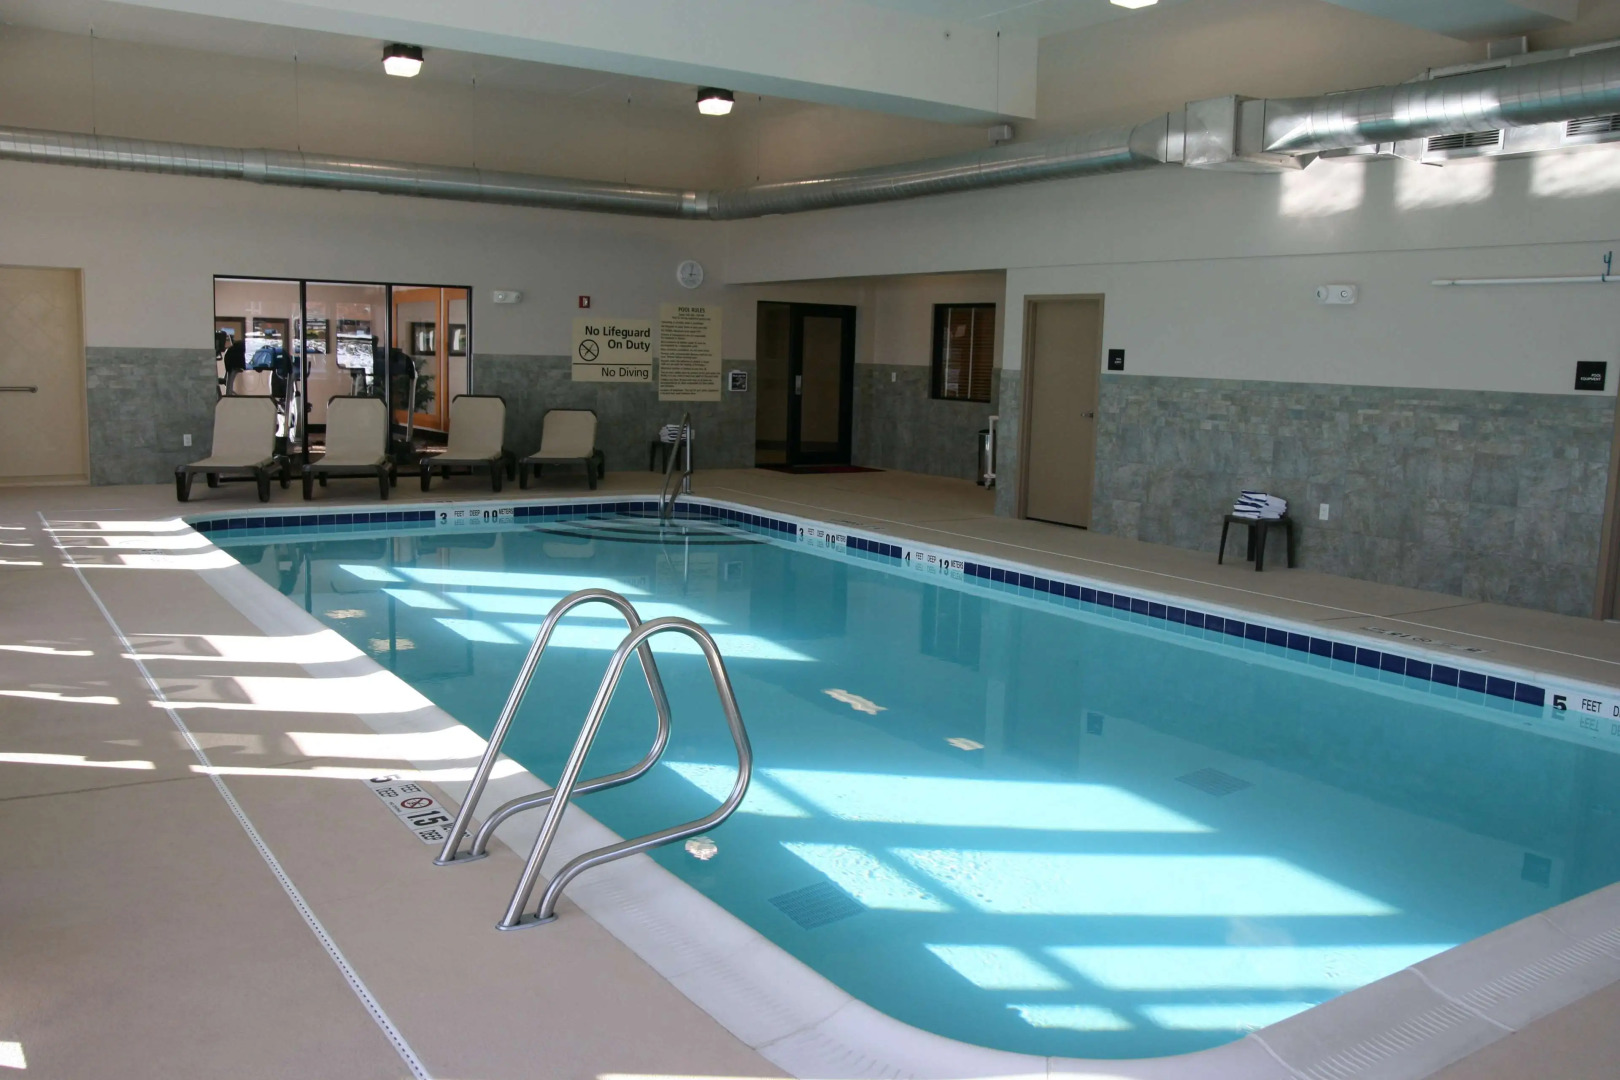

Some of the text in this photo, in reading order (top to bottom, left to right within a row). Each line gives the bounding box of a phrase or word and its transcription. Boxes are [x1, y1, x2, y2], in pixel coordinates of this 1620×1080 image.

[585, 325, 600, 336] No
[603, 326, 651, 339] Lifeguard
[608, 339, 623, 349] On
[626, 340, 651, 352] Duty
[601, 367, 616, 377] No
[619, 367, 649, 379] Diving
[916, 552, 924, 561] FEET
[927, 554, 936, 563] DEEP
[950, 560, 964, 569] METERS
[1553, 694, 1567, 711] 5
[1581, 698, 1602, 713] FEET
